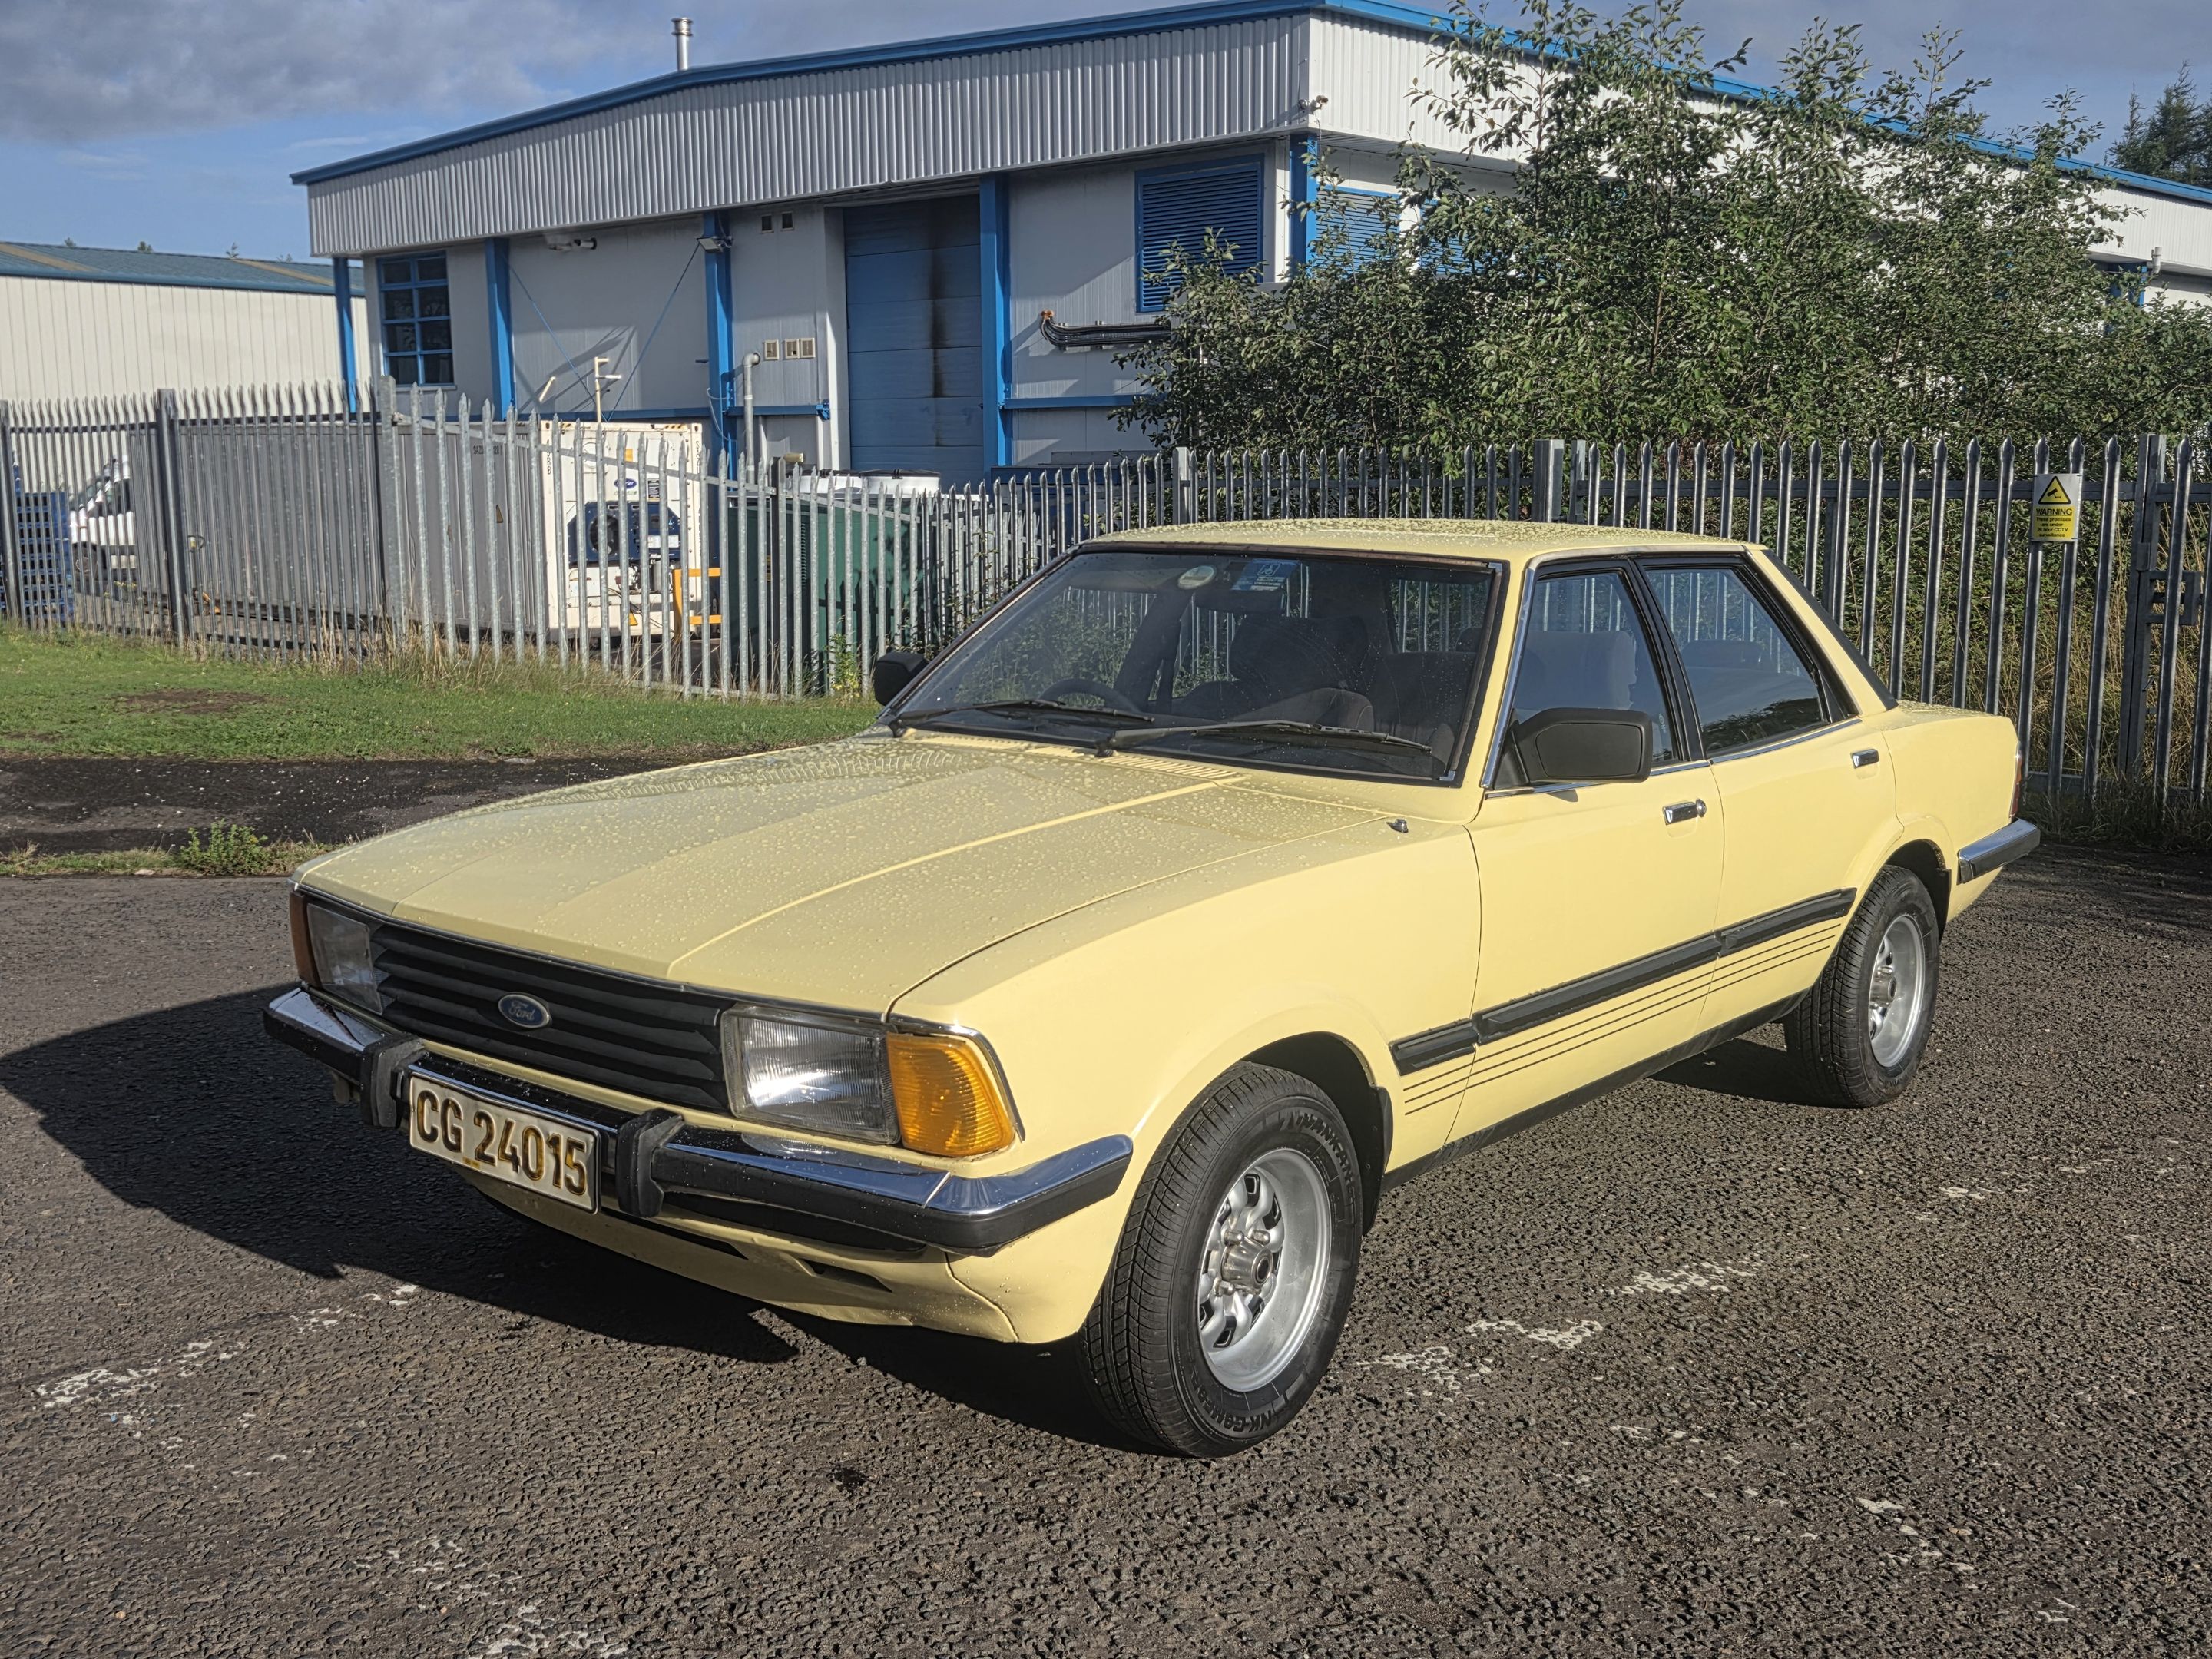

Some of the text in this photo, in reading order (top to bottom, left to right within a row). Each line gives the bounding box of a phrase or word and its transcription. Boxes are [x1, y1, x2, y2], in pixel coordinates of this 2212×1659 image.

[508, 999, 535, 1021] Ford
[417, 1089, 587, 1195] CG 24015
[1298, 1111, 1353, 1194] NANKANG
